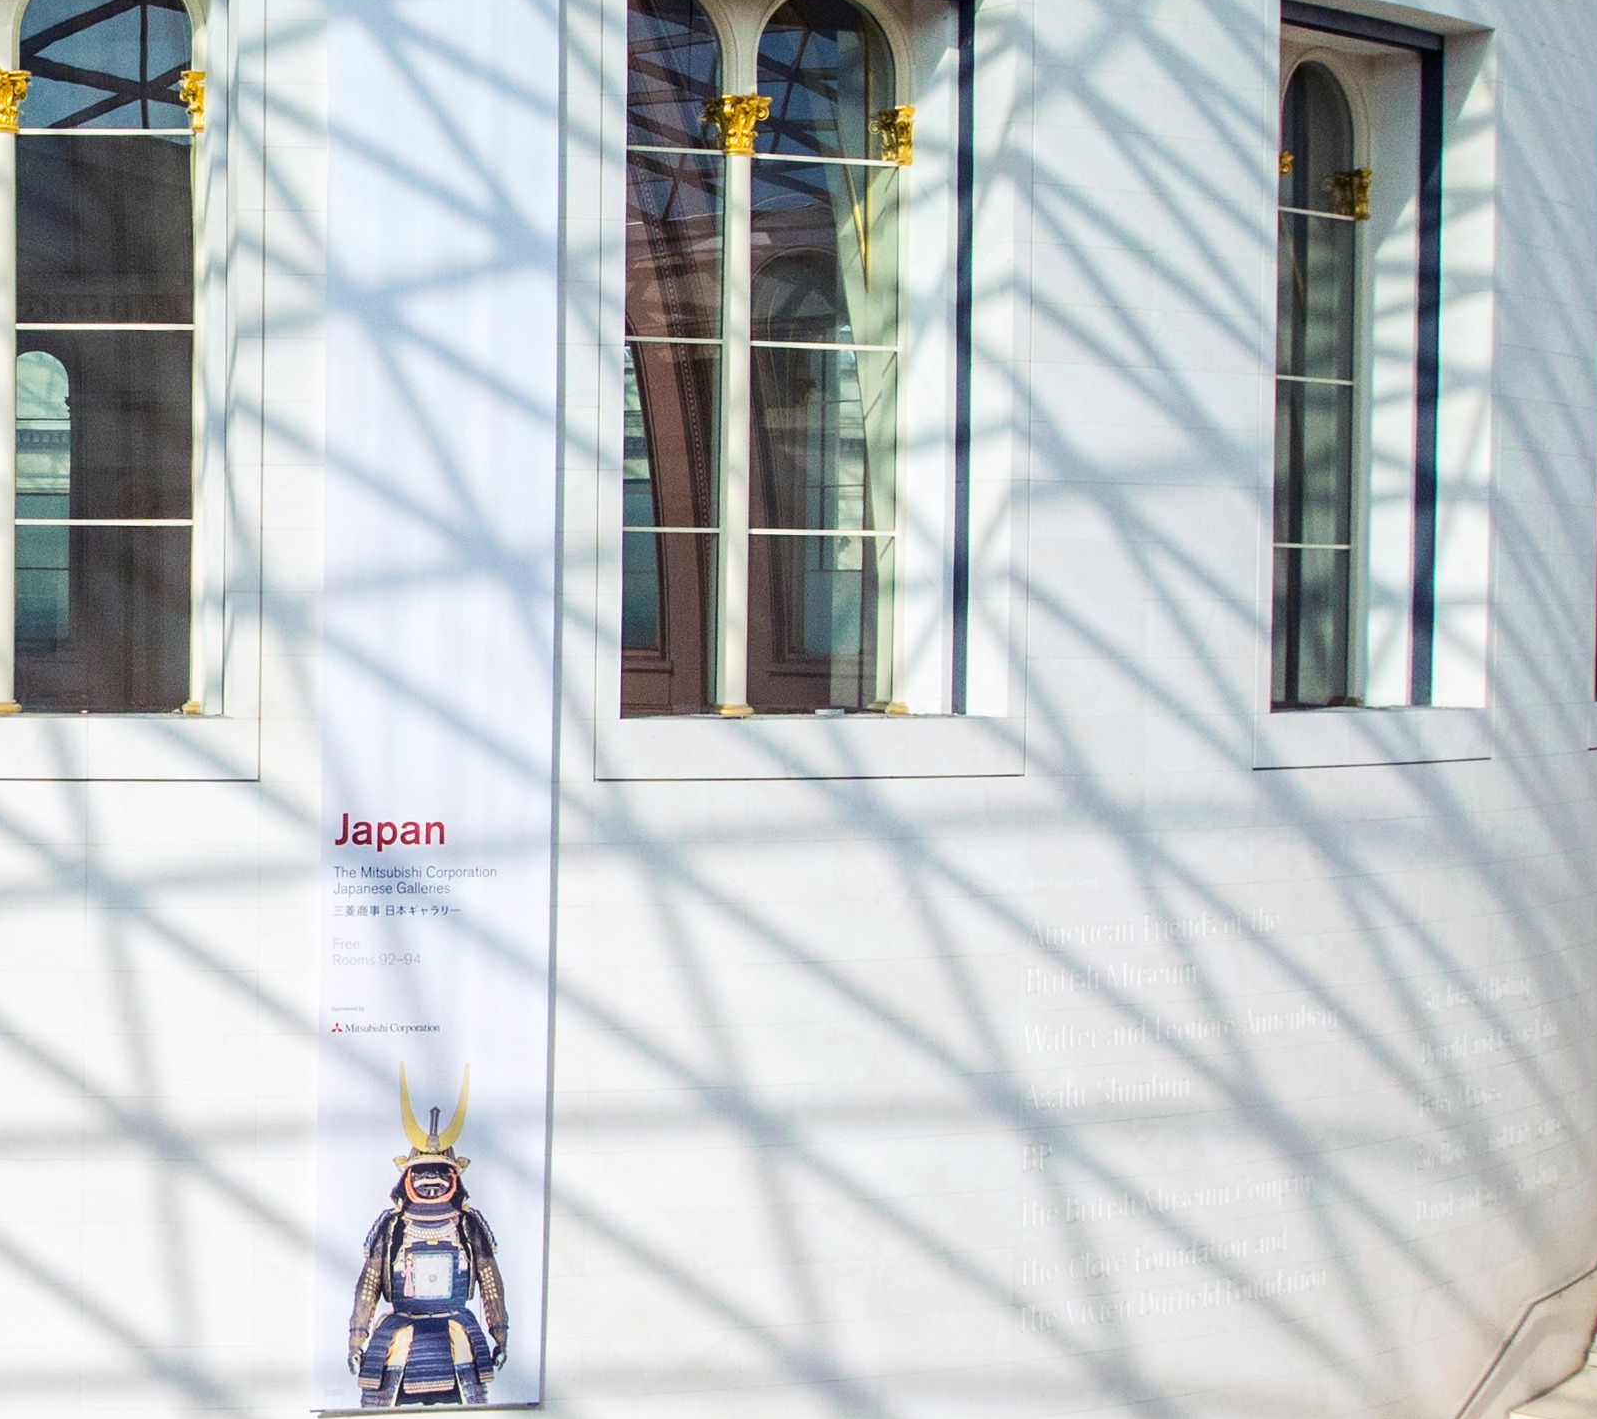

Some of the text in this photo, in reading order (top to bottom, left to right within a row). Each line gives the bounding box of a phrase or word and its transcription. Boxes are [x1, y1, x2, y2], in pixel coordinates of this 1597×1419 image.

[334, 812, 445, 852] Japan
[334, 866, 498, 882] The Mitsubishi Corporation
[333, 882, 450, 897] Japanese Galleries
[332, 937, 361, 951] Free
[332, 954, 375, 966] Rooms
[344, 1022, 440, 1034] Mitsubishi Corporation
